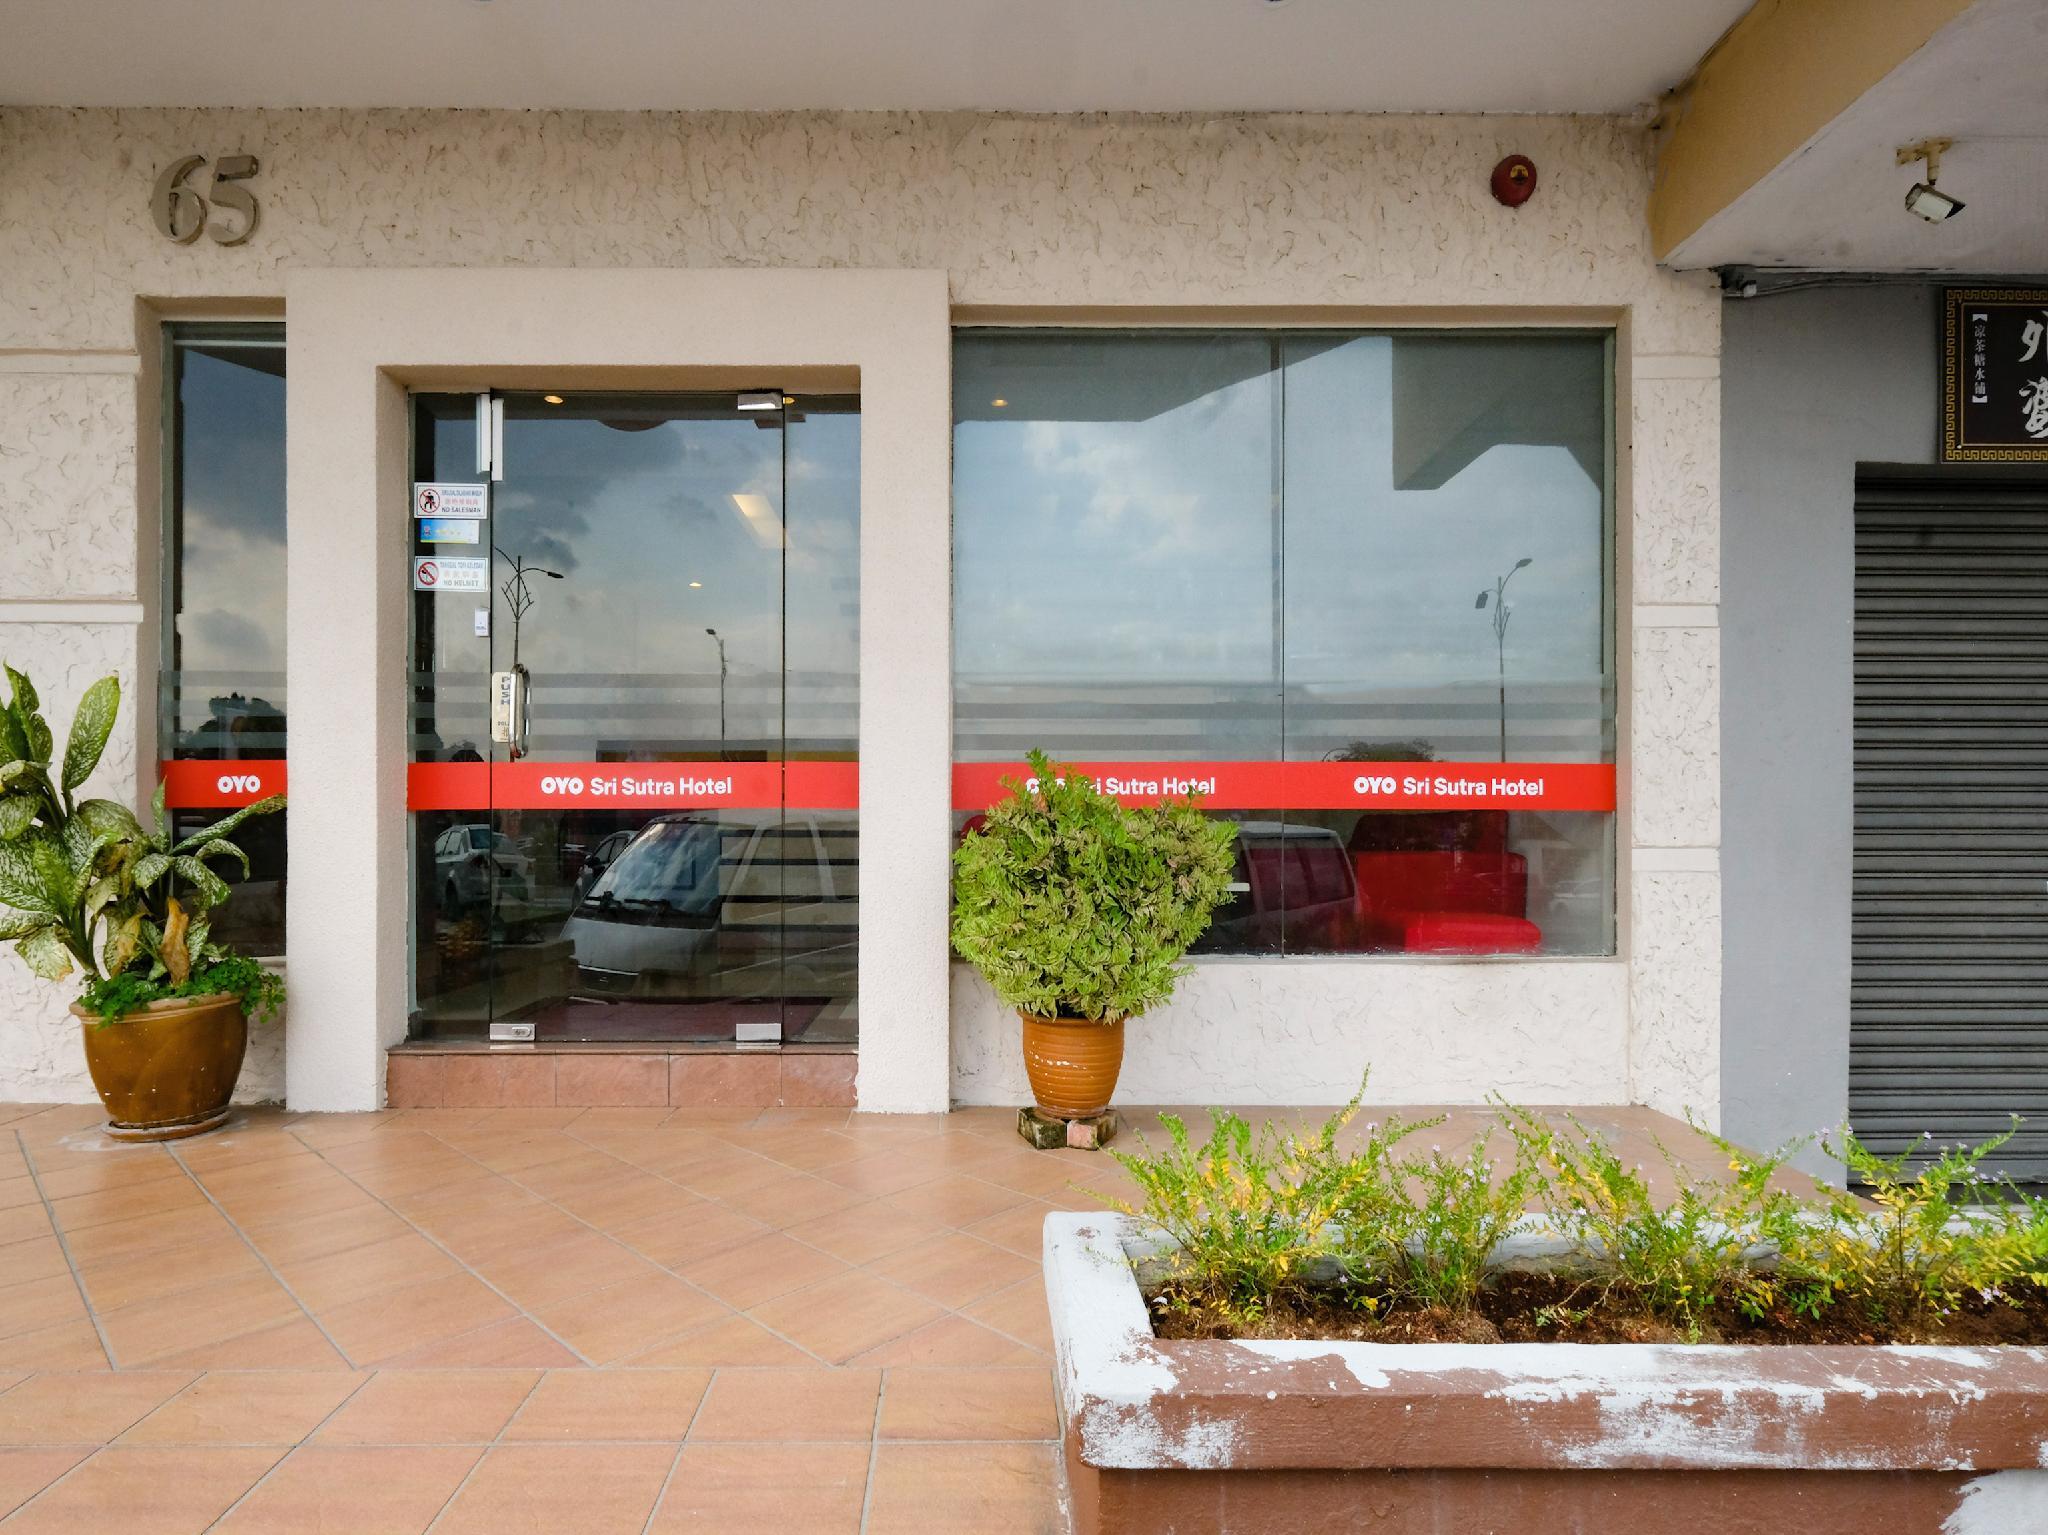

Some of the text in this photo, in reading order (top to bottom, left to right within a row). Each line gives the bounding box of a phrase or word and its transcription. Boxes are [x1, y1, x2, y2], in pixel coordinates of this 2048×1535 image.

[150, 154, 261, 247] 65
[217, 774, 261, 794] OYO
[540, 776, 732, 796] OYO Sri Sutra Hotel
[1105, 777, 1158, 796] Sutra
[1162, 776, 1215, 796] Hotel
[1353, 776, 1544, 797] OYO Sri Sutra Hotel
